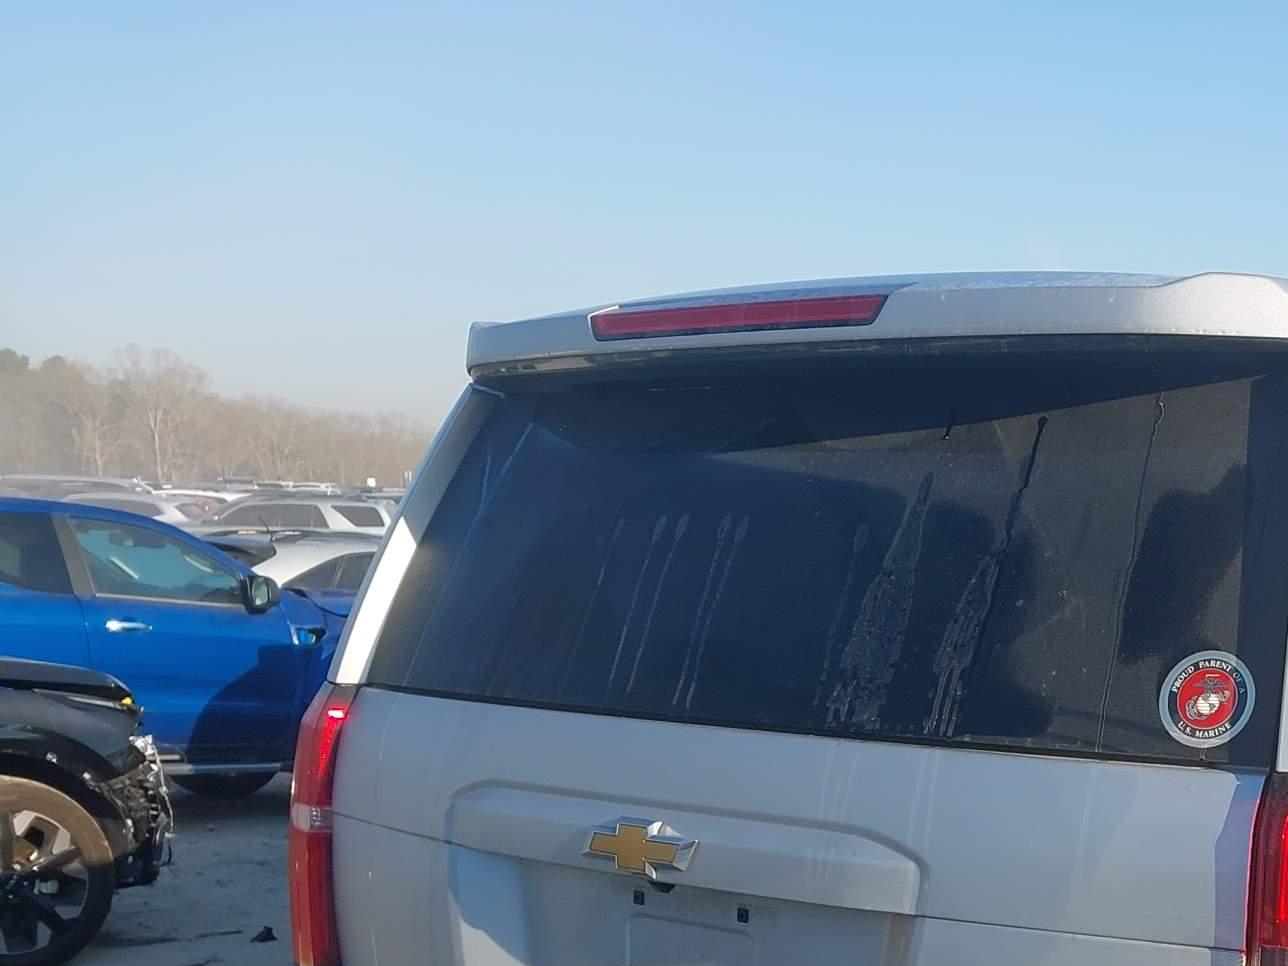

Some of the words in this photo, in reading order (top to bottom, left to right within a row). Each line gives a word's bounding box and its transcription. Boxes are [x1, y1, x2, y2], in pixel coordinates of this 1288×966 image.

[1171, 665, 1195, 693] PROUD
[1199, 660, 1233, 672] PARENT
[1233, 672, 1243, 683] OF
[1177, 720, 1192, 736] U.S.
[1195, 722, 1232, 738] MARINE
